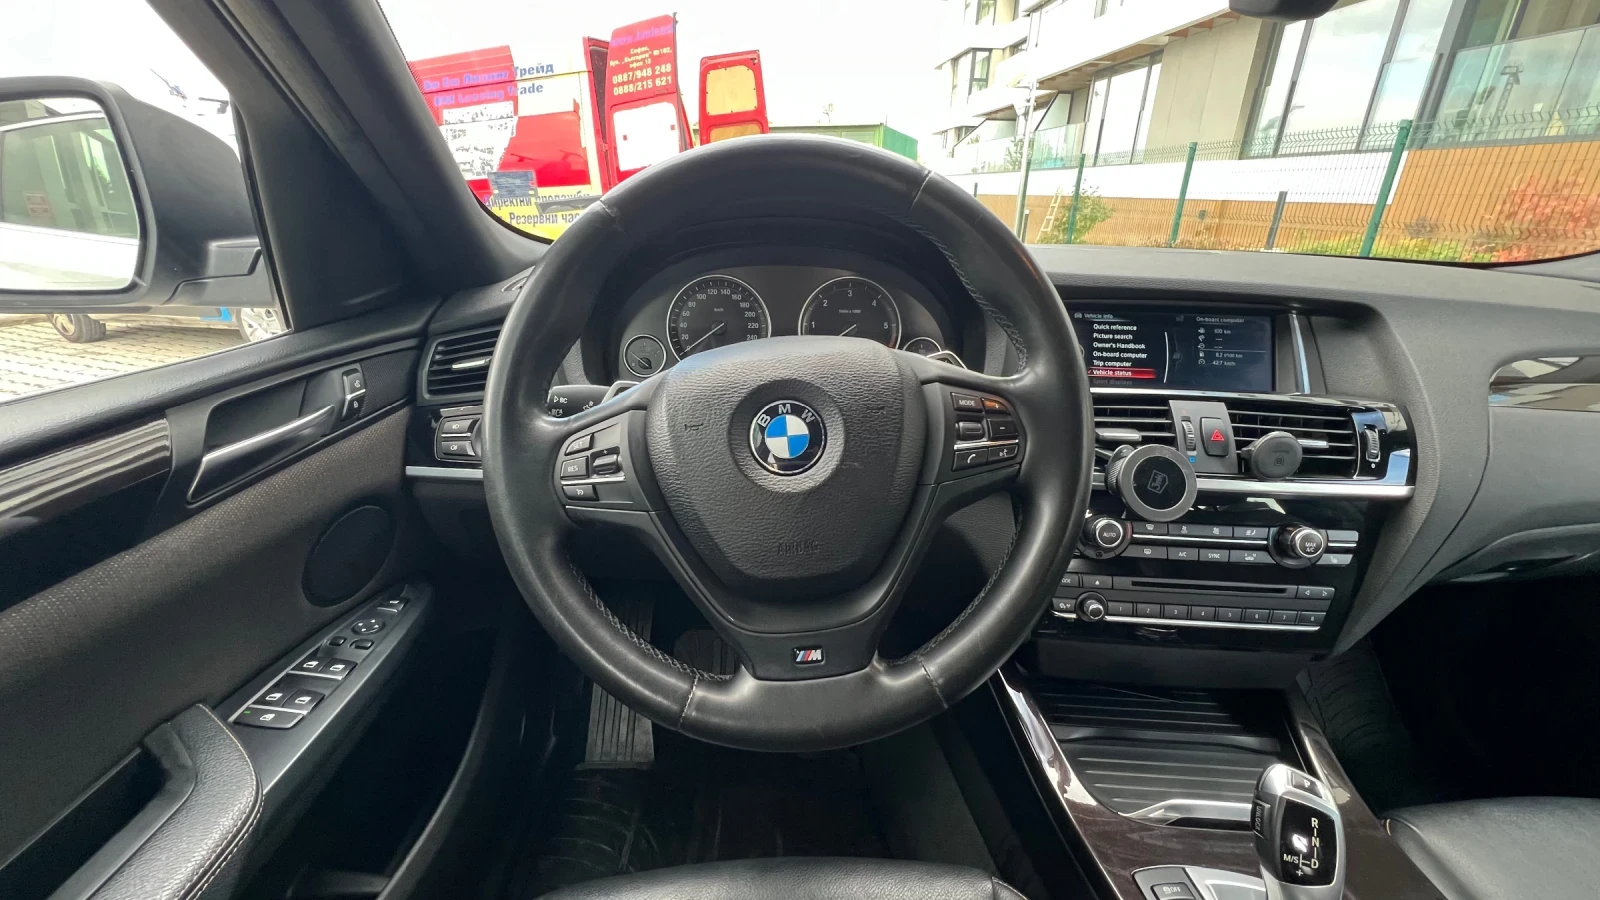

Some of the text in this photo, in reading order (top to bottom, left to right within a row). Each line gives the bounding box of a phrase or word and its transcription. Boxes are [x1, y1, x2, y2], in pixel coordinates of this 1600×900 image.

[612, 63, 672, 84] 0887/948 248
[508, 83, 544, 97] Trade
[613, 76, 672, 96] 0888/215 621
[509, 212, 558, 227] Резервни
[847, 289, 853, 297] 3
[811, 321, 816, 329] 1
[757, 403, 816, 428] BMW
[1303, 779, 1311, 788] P
[1311, 817, 1319, 828] R
[1311, 836, 1320, 847] N
[1283, 853, 1299, 864] M/S
[1310, 858, 1319, 869] D
